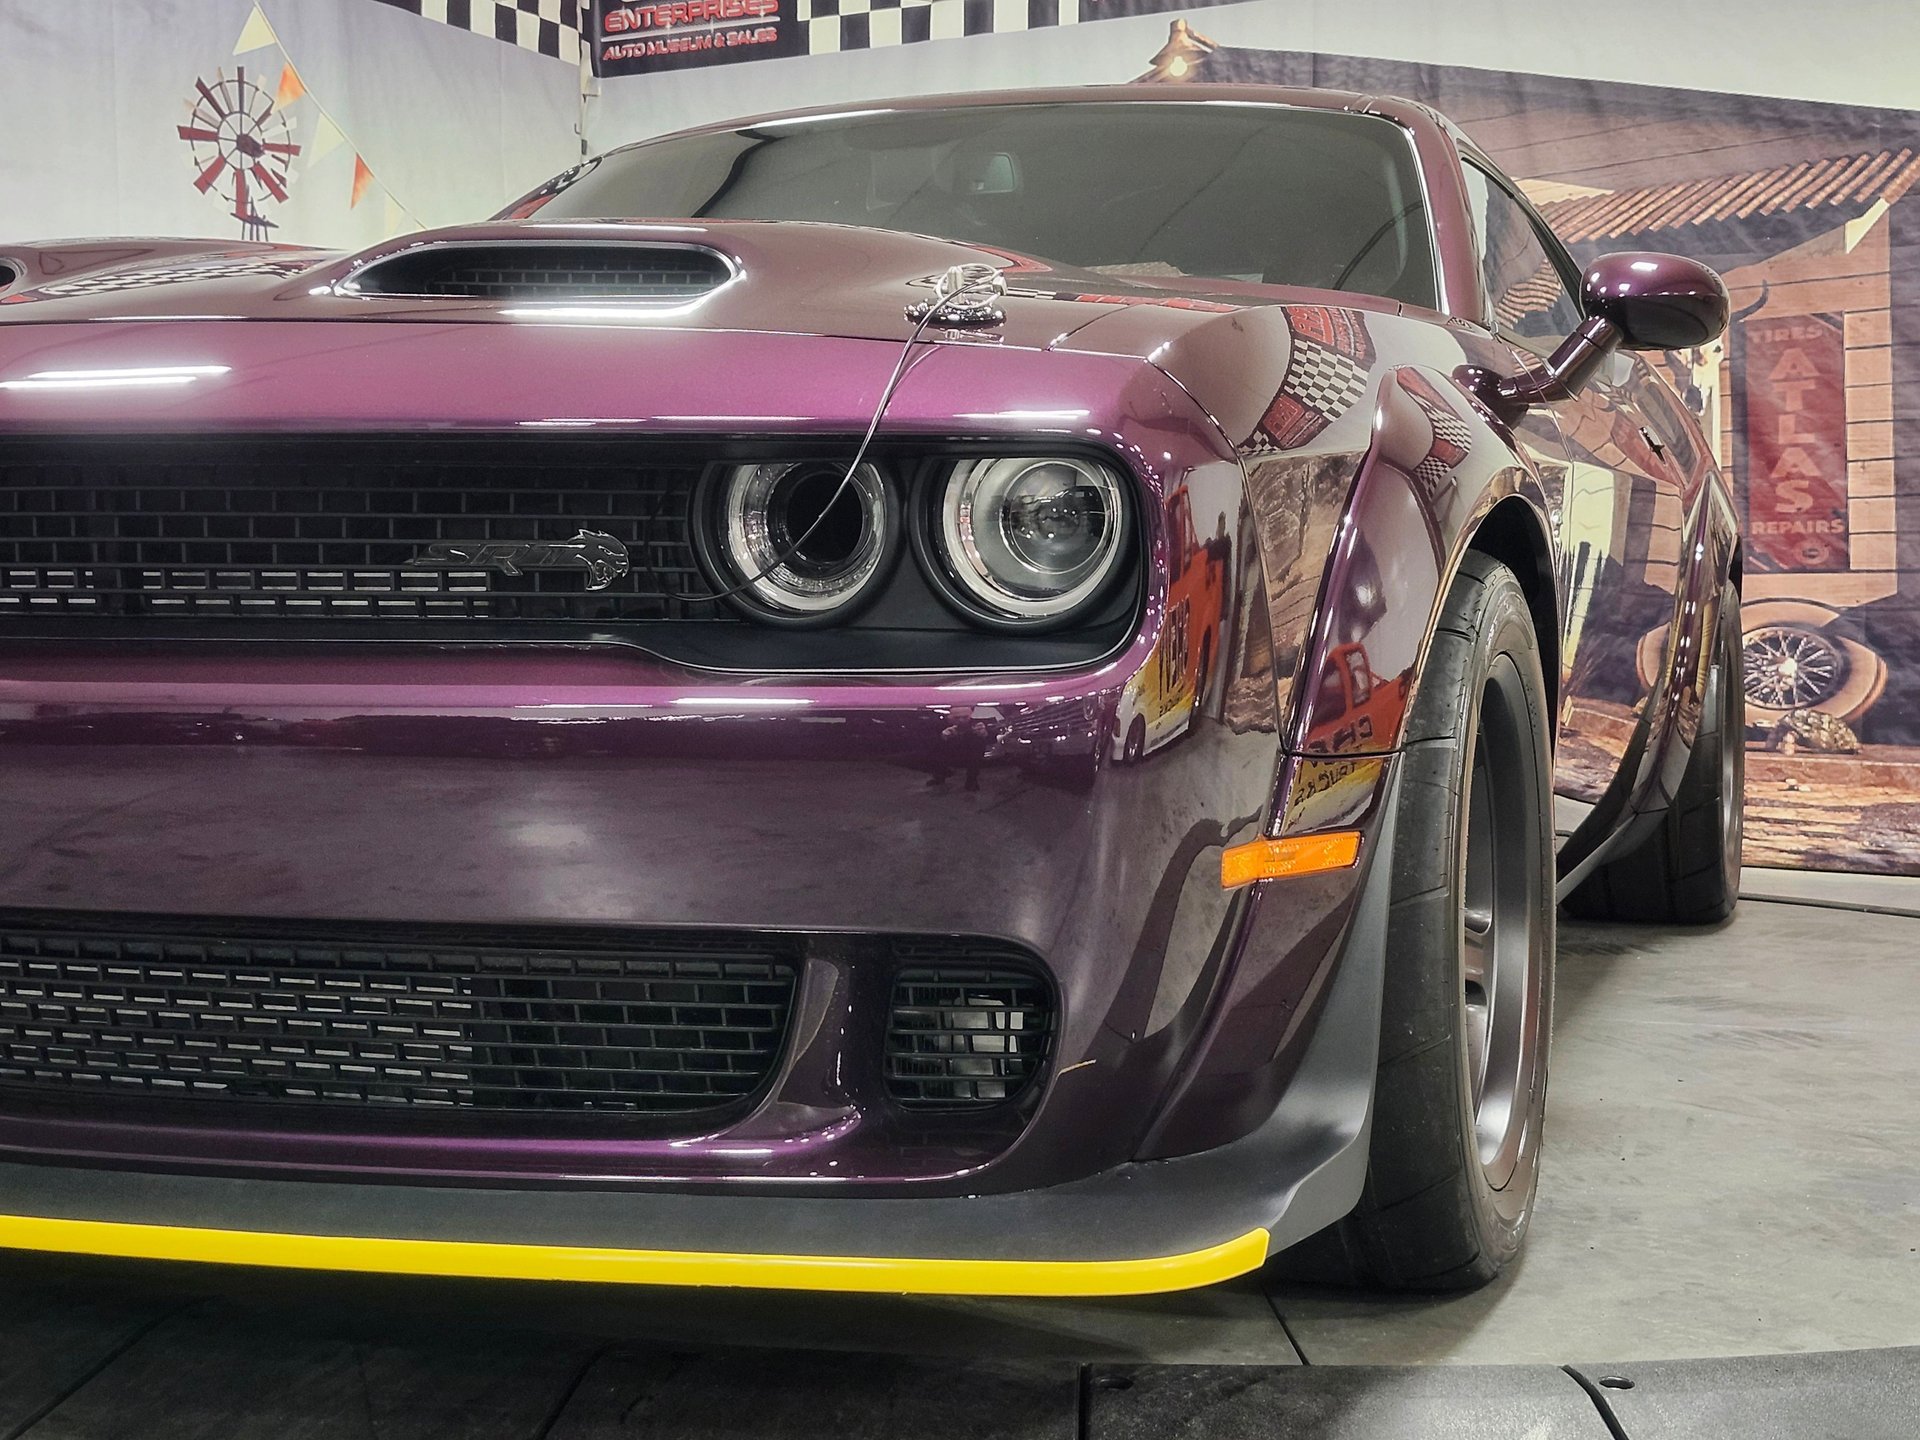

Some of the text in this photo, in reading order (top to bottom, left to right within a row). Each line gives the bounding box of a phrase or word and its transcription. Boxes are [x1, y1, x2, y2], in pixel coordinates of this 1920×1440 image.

[605, 0, 778, 32] ENTERPRISES
[603, 27, 778, 60] AUTO MUSEUM & SALES
[1750, 325, 1823, 343] TIRES
[1768, 347, 1822, 514] ATLAS
[1751, 519, 1845, 535] REPAIRS
[414, 542, 584, 577] SRT
